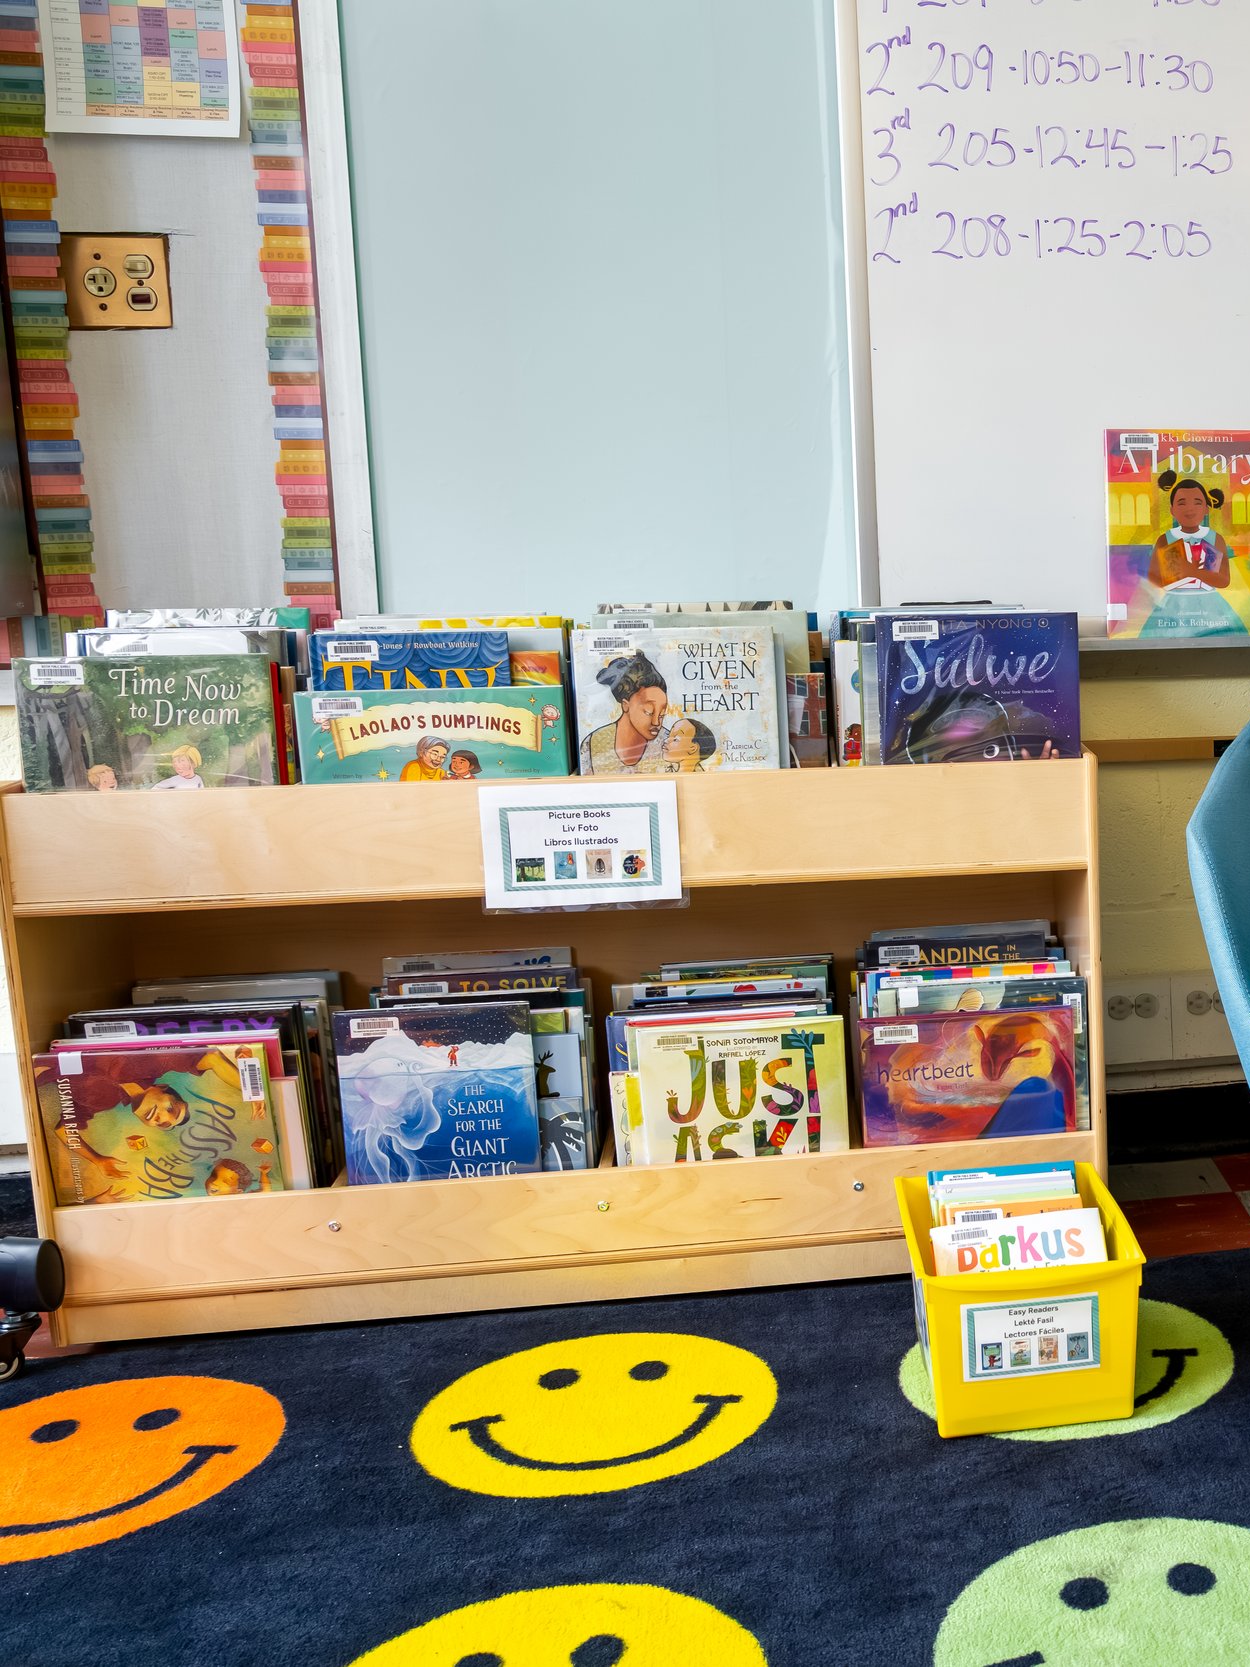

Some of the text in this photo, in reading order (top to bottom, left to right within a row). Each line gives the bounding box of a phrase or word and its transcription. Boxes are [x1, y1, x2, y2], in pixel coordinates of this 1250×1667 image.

[917, 42, 994, 93] 209
[1182, 432, 1233, 443] Giovanni
[1117, 449, 1140, 474] A
[941, 619, 968, 633] ITA
[1158, 619, 1177, 627] Erin
[1190, 618, 1230, 628] Robinson
[413, 640, 479, 650] Rowboat Watkins
[678, 641, 758, 658] WHAT IS
[682, 660, 756, 680] GIVEN
[900, 634, 1058, 694] Sulwe
[108, 666, 176, 697] Time
[182, 674, 241, 702] Now
[700, 682, 739, 691] from the
[682, 692, 759, 713] HEART
[129, 699, 241, 727] to Dream
[432, 715, 521, 736] DUMPLINGS
[548, 810, 611, 820] Picture Books
[562, 824, 599, 833] Liv Foto
[544, 836, 619, 847] Libros Ilustrados
[498, 976, 568, 991] SOLVE
[706, 1036, 779, 1047] SONIA SOTOMAYOR
[718, 1051, 743, 1059] RAFAEL
[666, 1029, 825, 1124] JUST
[877, 1062, 974, 1085] heartbeat
[463, 1084, 486, 1096] THE
[57, 1078, 75, 1120] SUSANNA
[447, 1100, 504, 1117] SEARCH
[455, 1119, 502, 1132] FOR THE
[64, 1123, 81, 1150] REICH
[451, 1136, 510, 1157] GIANT
[71, 1156, 83, 1195] Illustrations
[448, 1160, 518, 1179] ARCTIC
[957, 1226, 1085, 1272] Darkus
[1008, 1305, 1059, 1316] Easy Readers
[1037, 1317, 1054, 1325] Fasil
[1004, 1327, 1065, 1339] Lectores Fáciles
